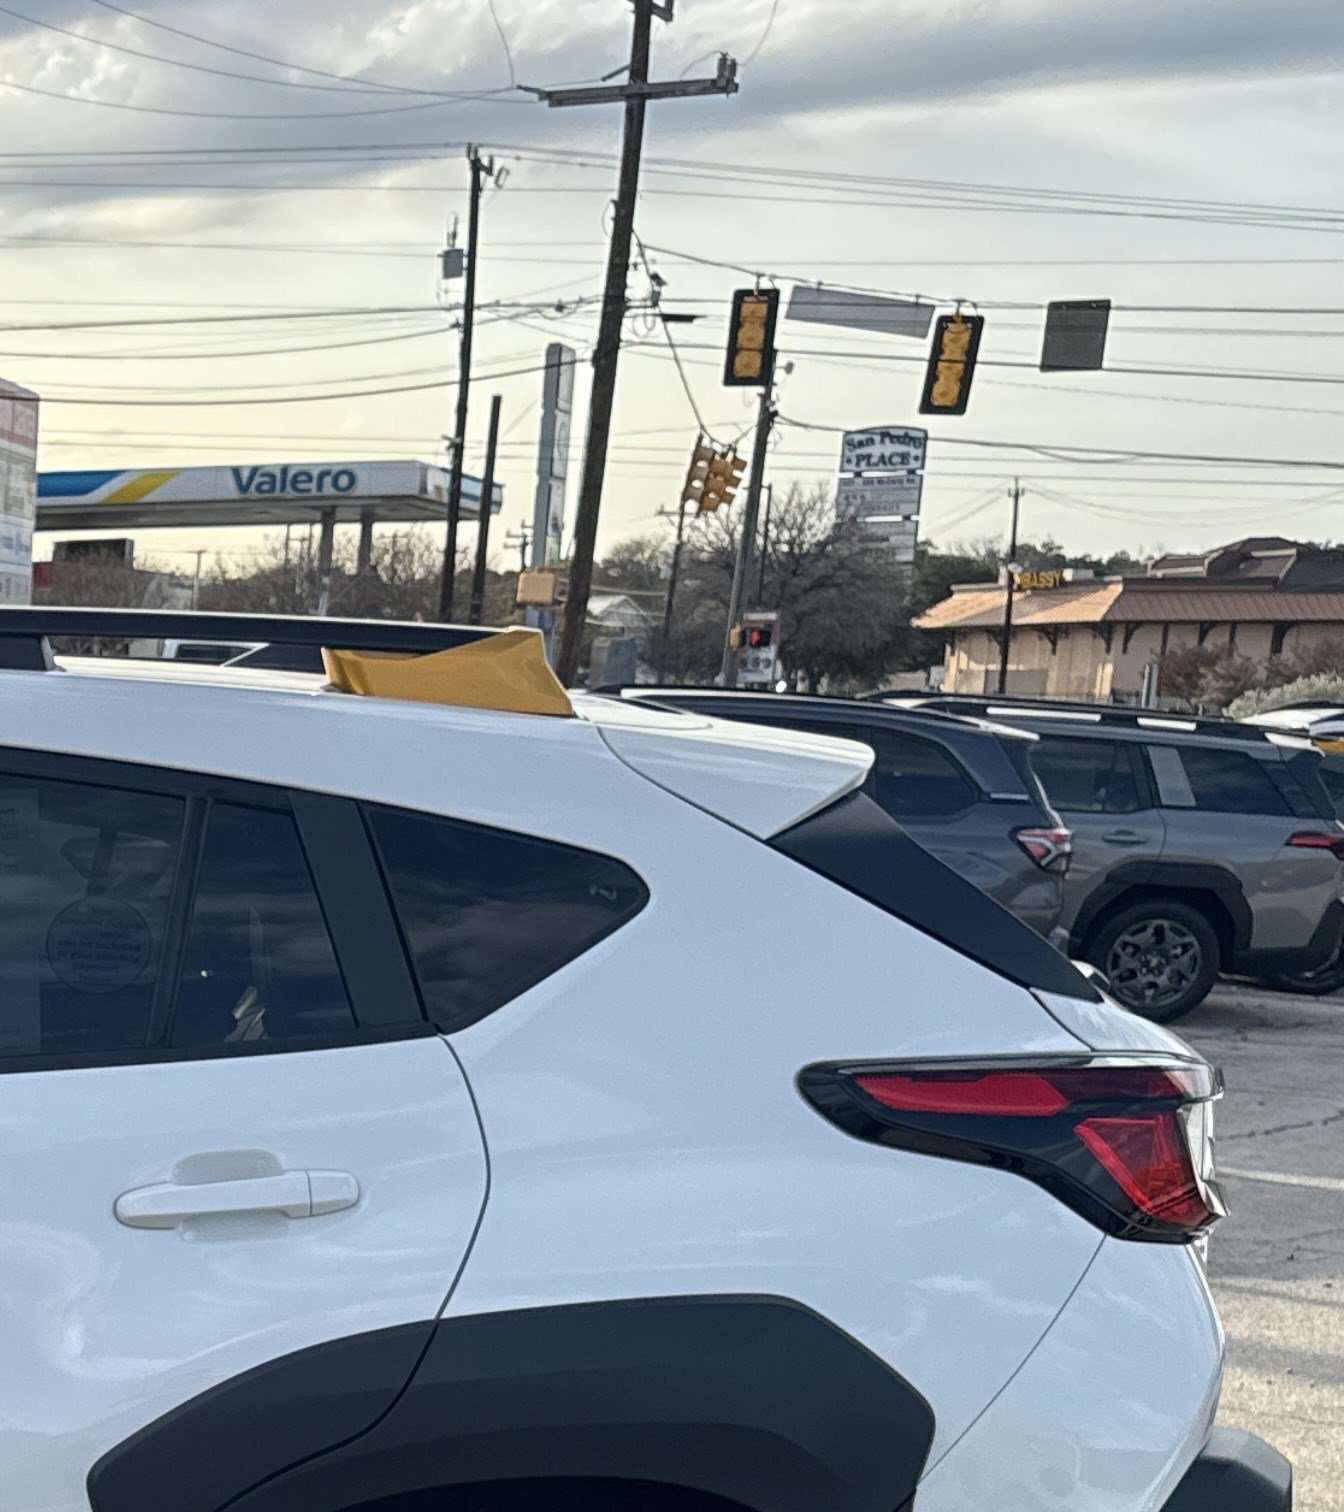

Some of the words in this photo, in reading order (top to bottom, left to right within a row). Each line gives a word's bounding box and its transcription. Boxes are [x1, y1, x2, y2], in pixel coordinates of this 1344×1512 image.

[855, 451, 911, 467] PLACE
[231, 465, 358, 495] Valero
[1013, 569, 1063, 590] BASSY
